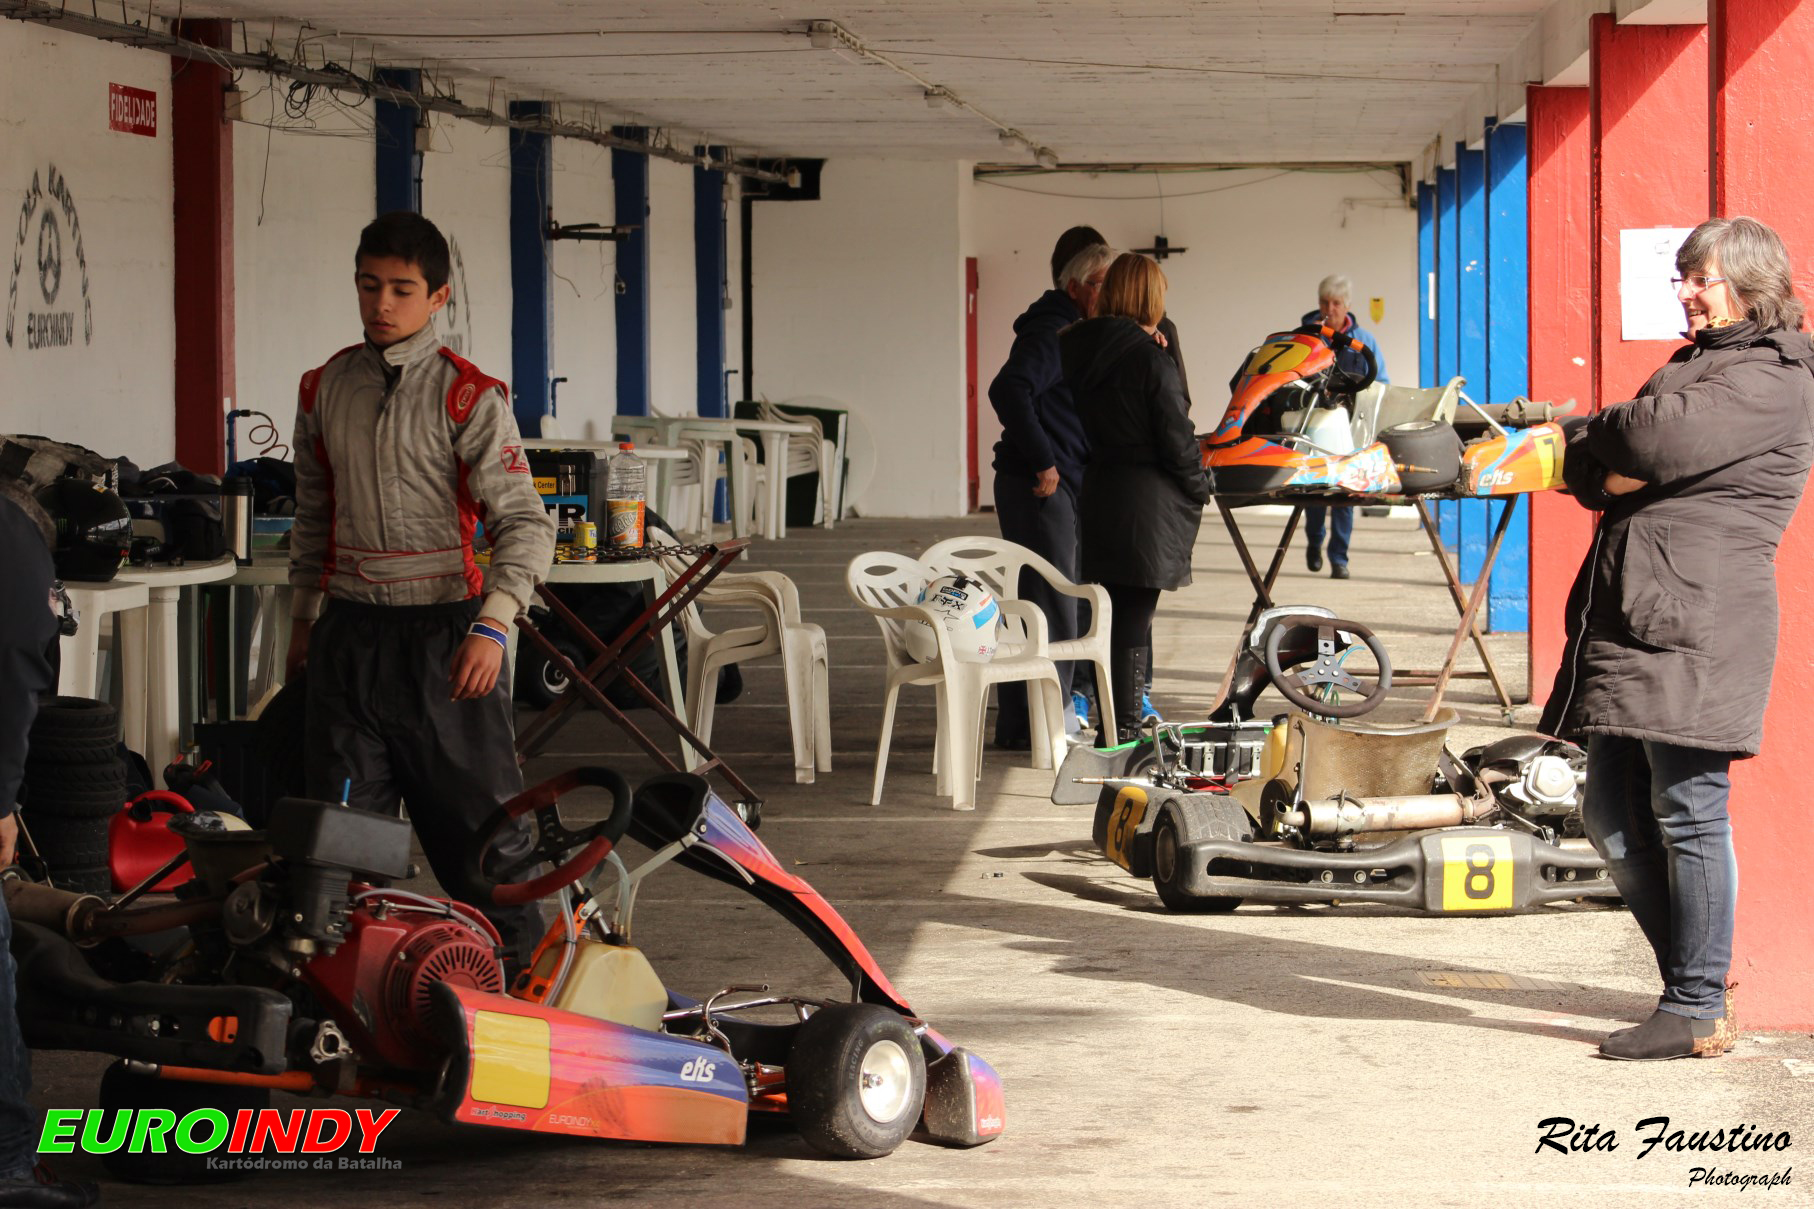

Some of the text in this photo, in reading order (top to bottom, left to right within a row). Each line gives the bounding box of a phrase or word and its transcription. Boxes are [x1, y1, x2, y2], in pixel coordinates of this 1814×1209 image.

[111, 92, 155, 128] FIDELIDADE
[27, 312, 75, 350] EUROINDY
[1258, 343, 1295, 375] 7
[1114, 797, 1134, 852] 8
[1464, 843, 1495, 900] 8
[849, 1038, 865, 1080] RACING
